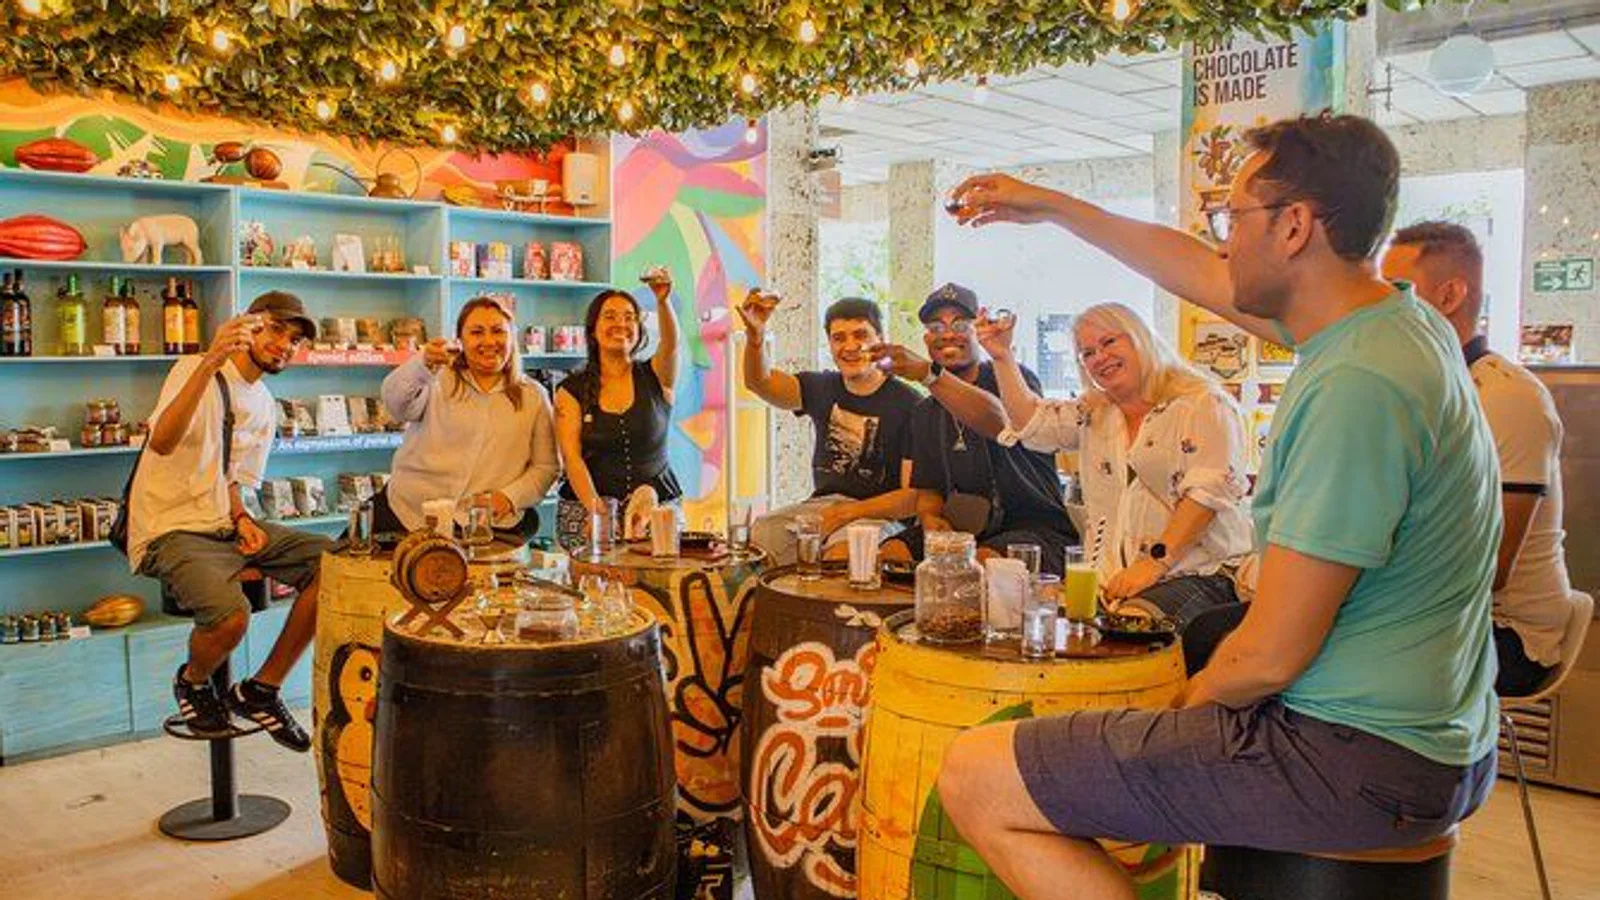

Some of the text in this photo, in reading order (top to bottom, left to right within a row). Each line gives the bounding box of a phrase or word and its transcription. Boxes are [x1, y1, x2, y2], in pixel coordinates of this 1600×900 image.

[1193, 43, 1298, 82] CHOCOLATE
[1193, 74, 1267, 107] IS MADE
